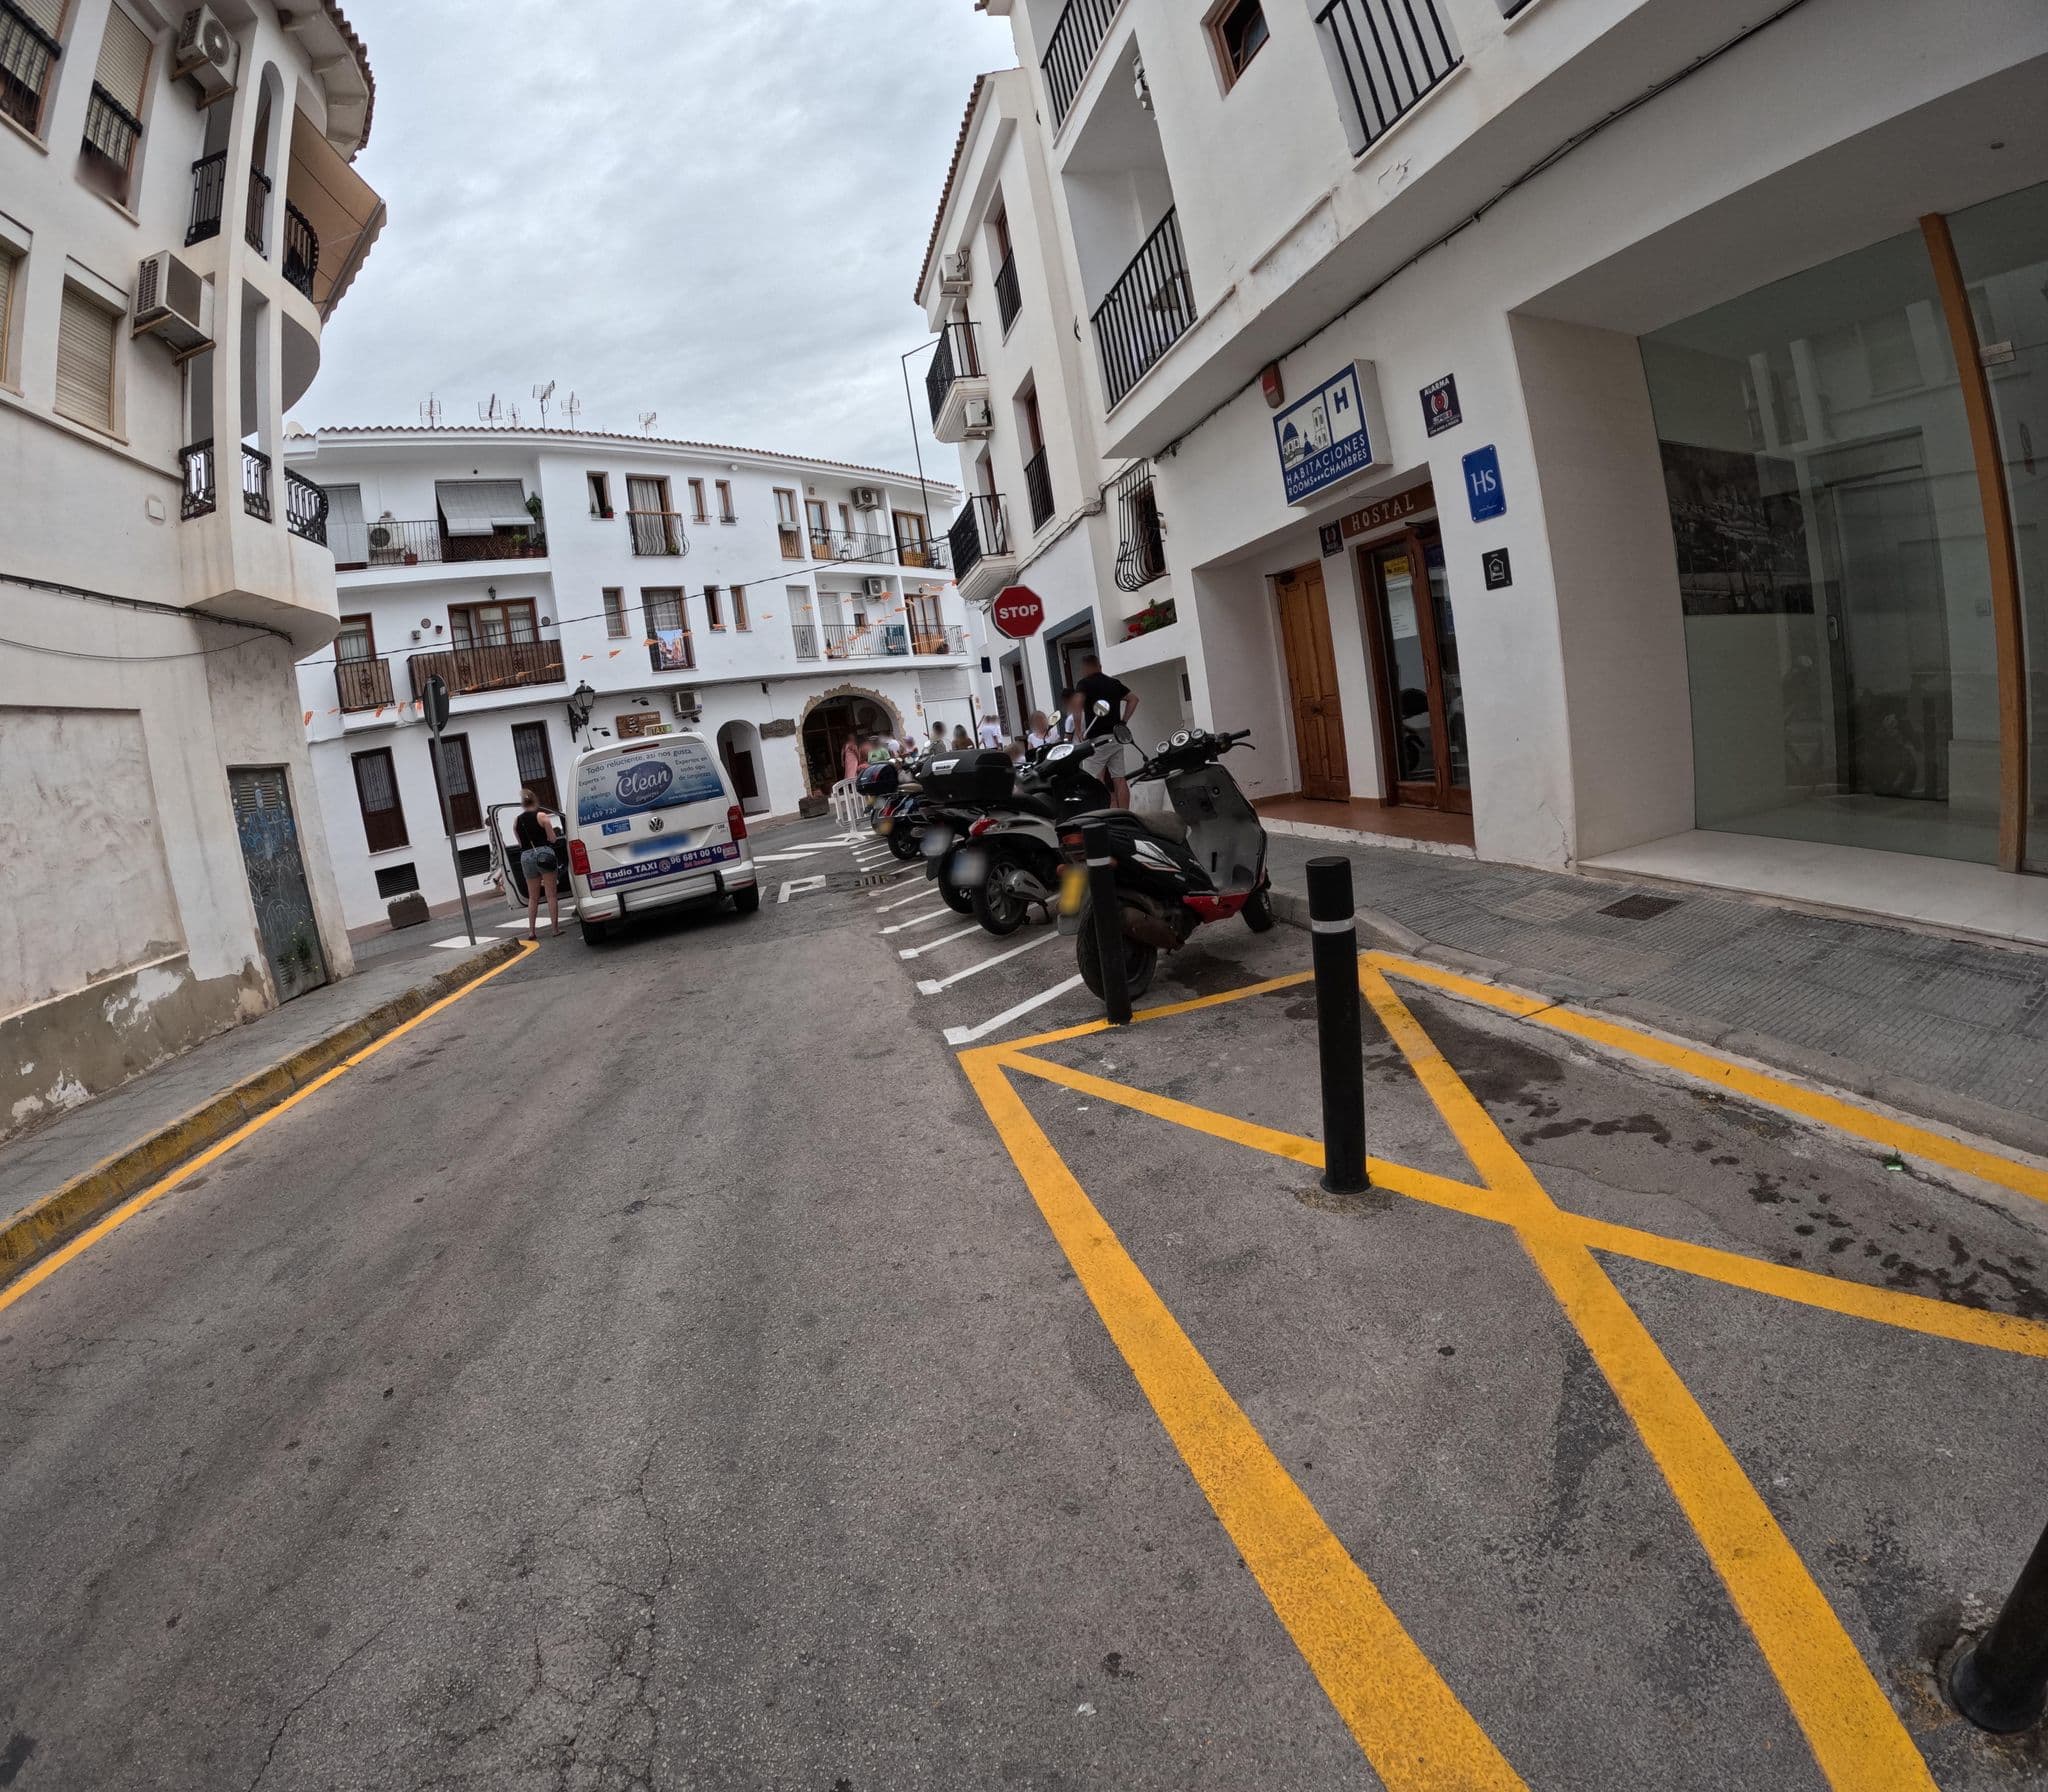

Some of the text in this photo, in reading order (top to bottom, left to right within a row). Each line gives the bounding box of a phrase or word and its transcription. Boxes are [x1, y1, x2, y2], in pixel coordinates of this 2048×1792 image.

[1424, 377, 1450, 396] ALARMA
[1333, 386, 1349, 414] H
[1286, 434, 1366, 486] HABITACIONES
[1470, 469, 1497, 497] HS
[1351, 494, 1415, 531] HOSTAL
[999, 604, 1039, 619] STOP
[586, 765, 605, 775] Todo
[618, 769, 669, 797] Clean
[670, 856, 681, 865] 96
[682, 852, 698, 862] 681
[699, 849, 711, 858] 00
[711, 846, 722, 855] 10
[605, 868, 632, 880] Radio
[634, 861, 658, 873] TAXI
